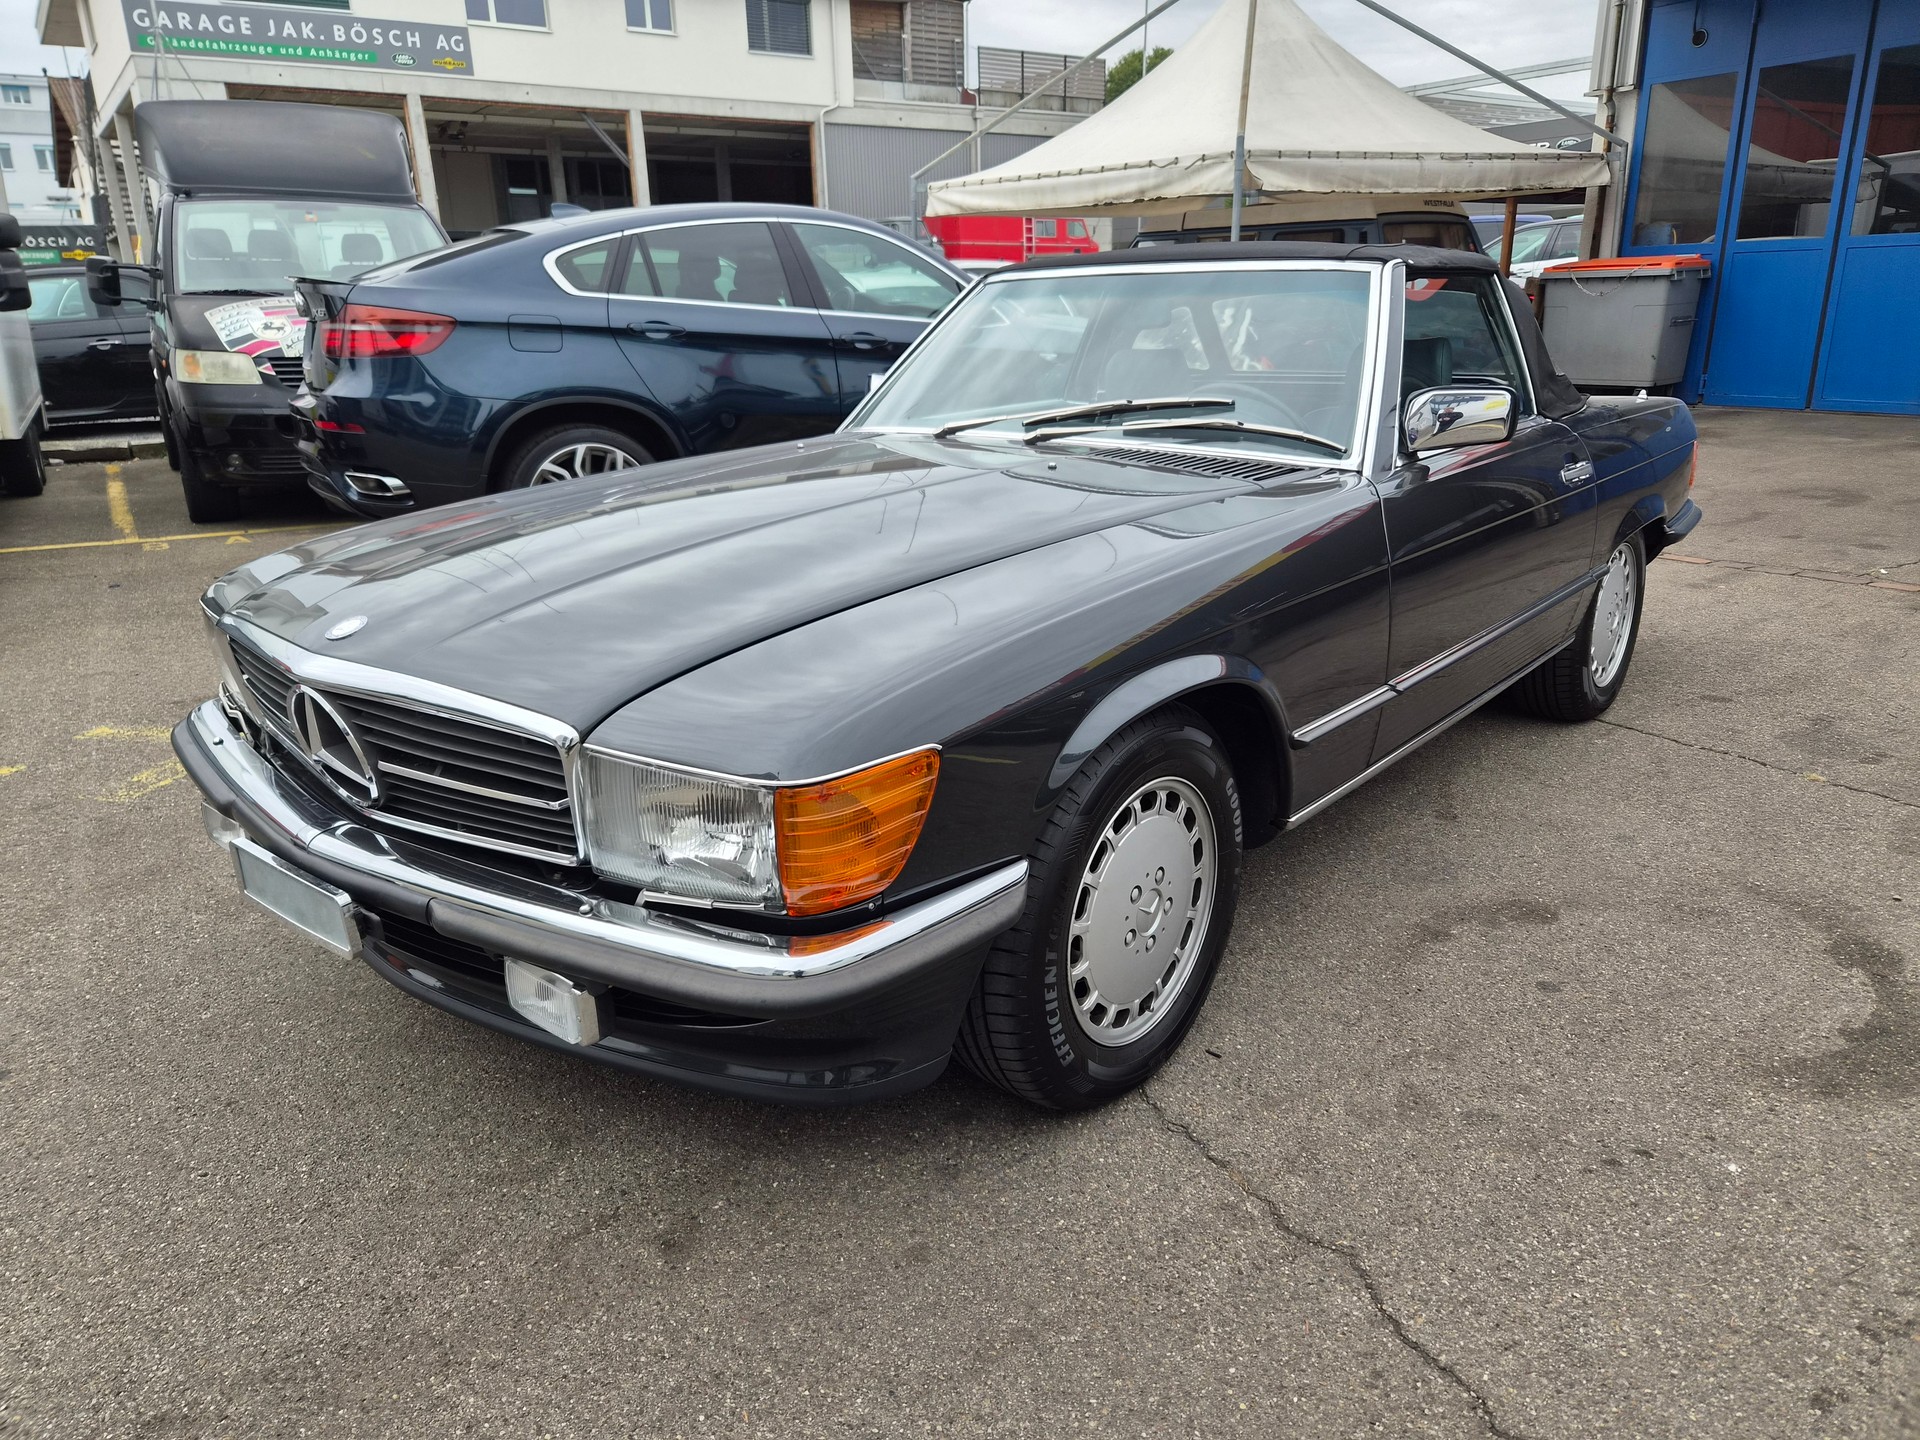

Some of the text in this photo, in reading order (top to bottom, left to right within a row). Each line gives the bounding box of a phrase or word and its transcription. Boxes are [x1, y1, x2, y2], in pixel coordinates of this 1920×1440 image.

[132, 8, 464, 51] GARAGE JAK. BÖSCH AG
[147, 36, 369, 61] Gändefahrzeuge und Anhänger
[1423, 199, 1455, 208] WESTFALIA
[20, 235, 94, 248] ÖSCH AG
[1044, 947, 1075, 1067] EFFICIENT
